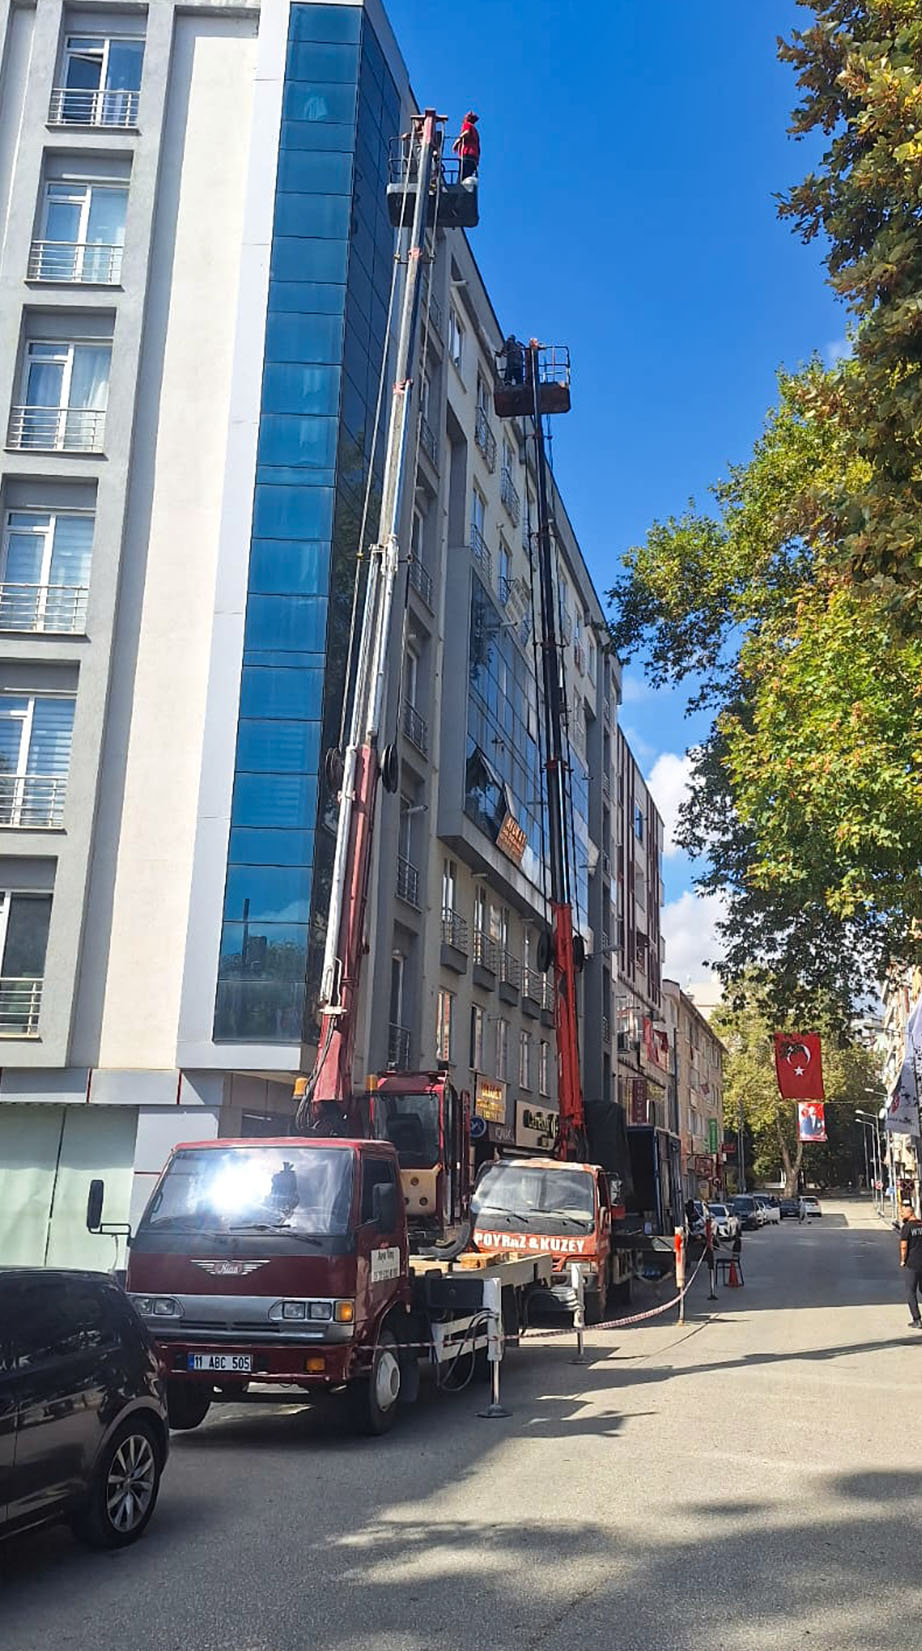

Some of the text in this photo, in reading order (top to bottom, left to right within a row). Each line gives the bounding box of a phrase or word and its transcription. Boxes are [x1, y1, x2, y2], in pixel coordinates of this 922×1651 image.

[529, 1237, 539, 1249] &
[540, 1237, 585, 1253] KUZEY
[195, 1356, 250, 1370] 11 ABC 505
